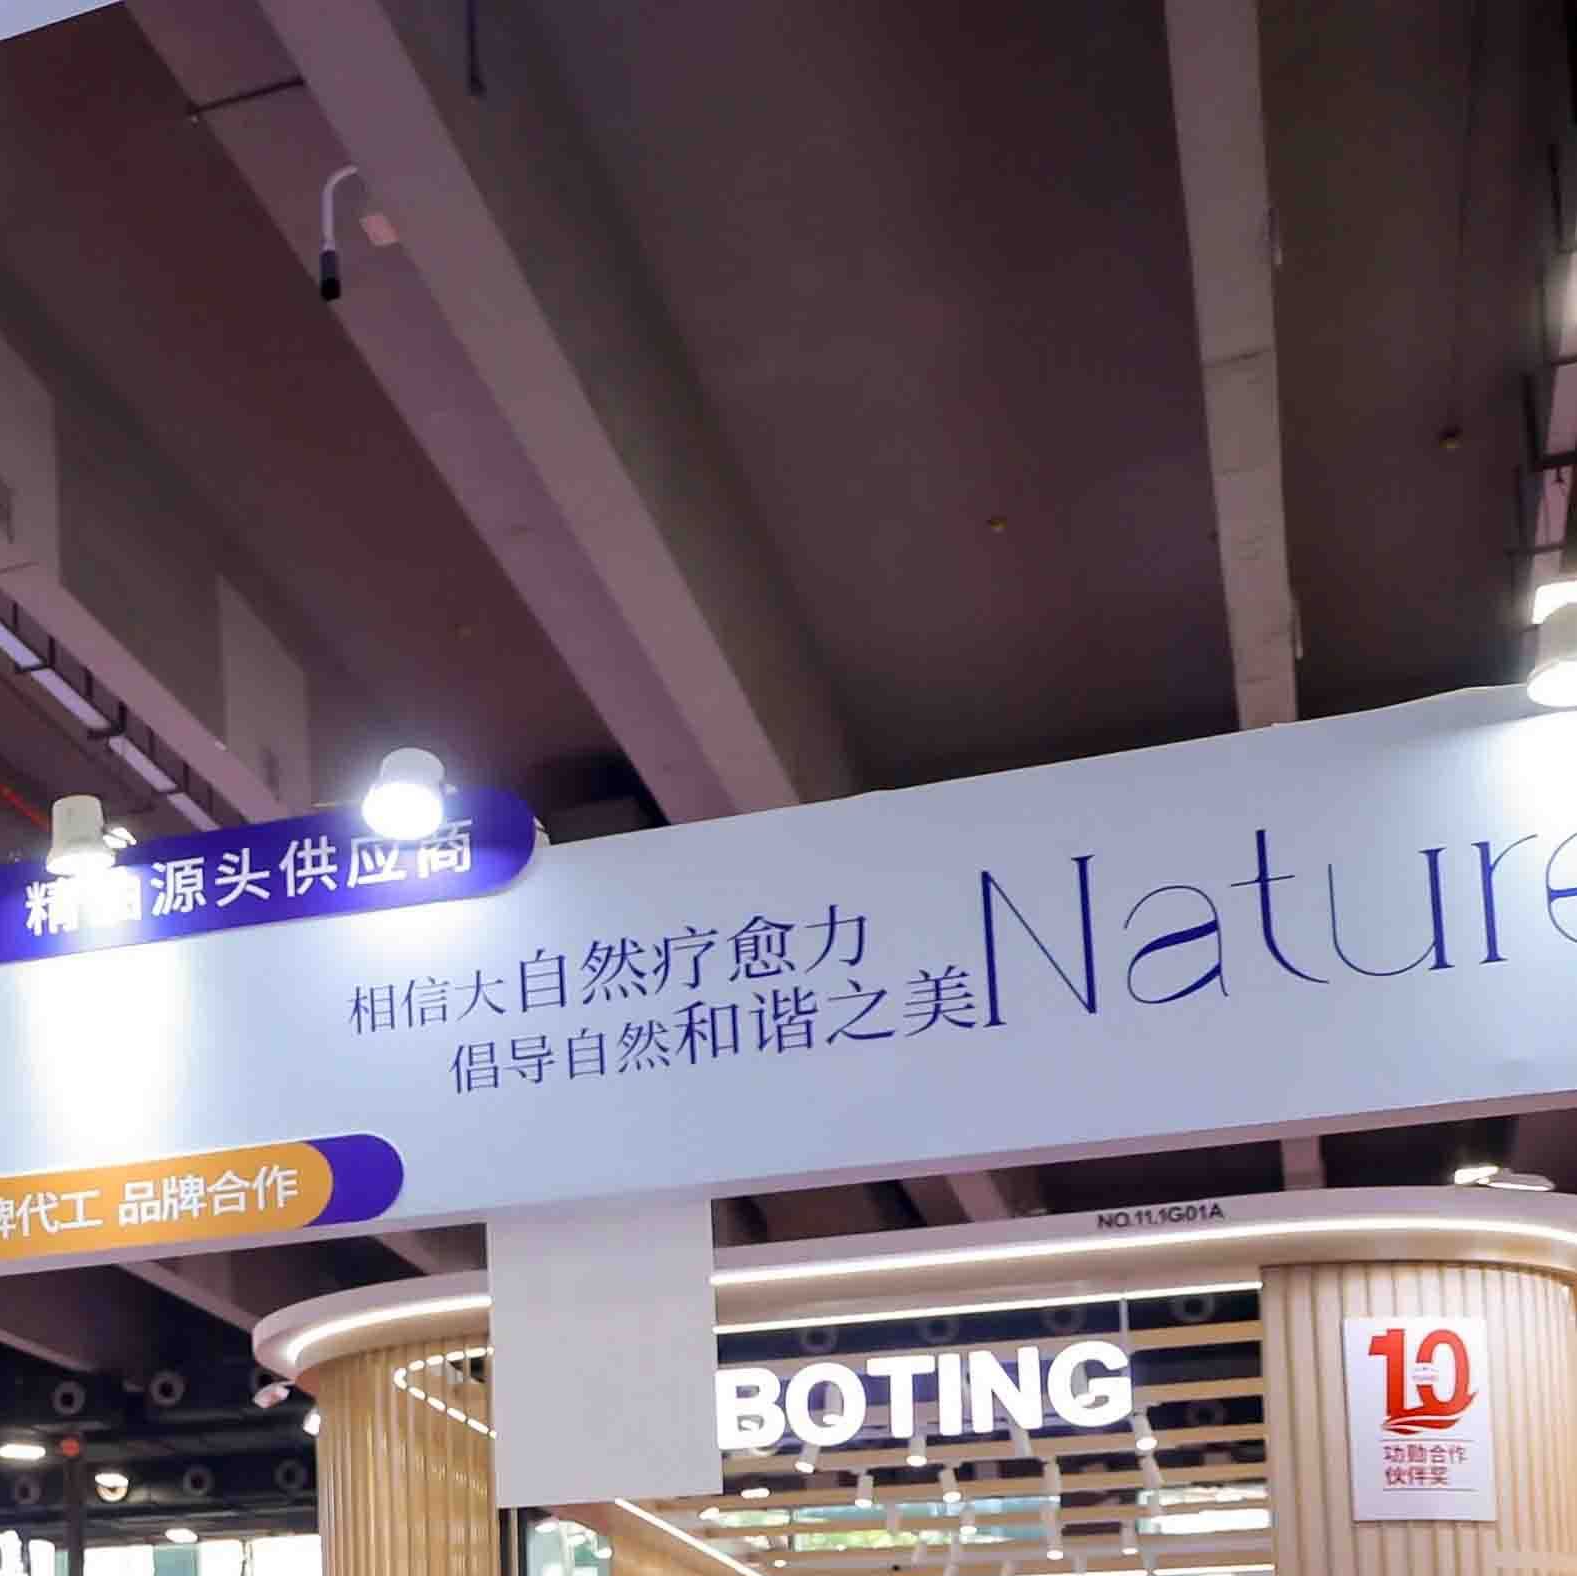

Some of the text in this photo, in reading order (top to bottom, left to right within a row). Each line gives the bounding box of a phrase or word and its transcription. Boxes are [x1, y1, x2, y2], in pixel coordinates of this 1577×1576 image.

[348, 903, 869, 1034] 相信大自然疗愈力
[448, 966, 980, 1096] 倡导自然和谐之美
[118, 1165, 300, 1226] 品牌合作
